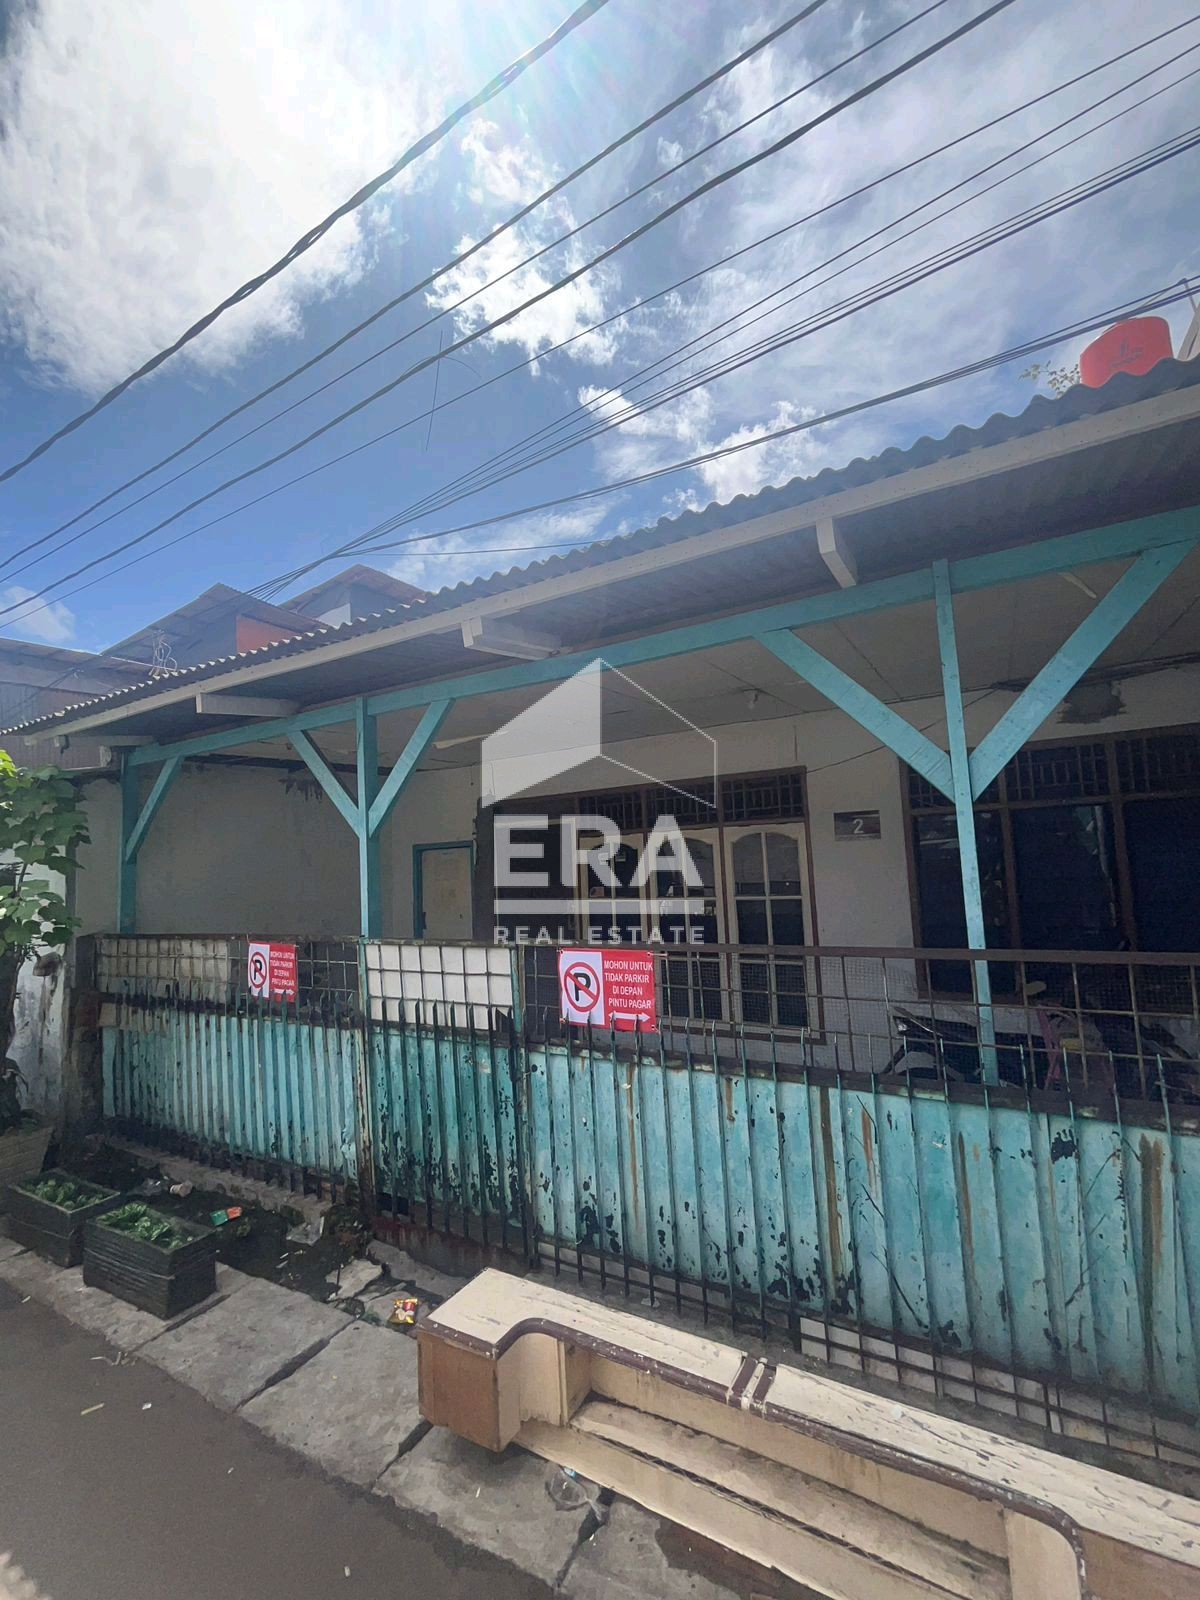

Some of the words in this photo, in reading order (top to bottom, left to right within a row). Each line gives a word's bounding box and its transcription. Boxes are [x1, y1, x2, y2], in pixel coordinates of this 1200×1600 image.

[853, 818, 865, 834] 2
[604, 960, 629, 970] MOHON
[629, 961, 653, 971] UNTUK
[605, 972, 624, 982] TIDAK
[624, 974, 649, 983] PARKIR
[612, 985, 620, 995] DI
[620, 986, 643, 996] DEPAN
[608, 997, 628, 1008] PINTU
[628, 999, 652, 1009] PAGAR
